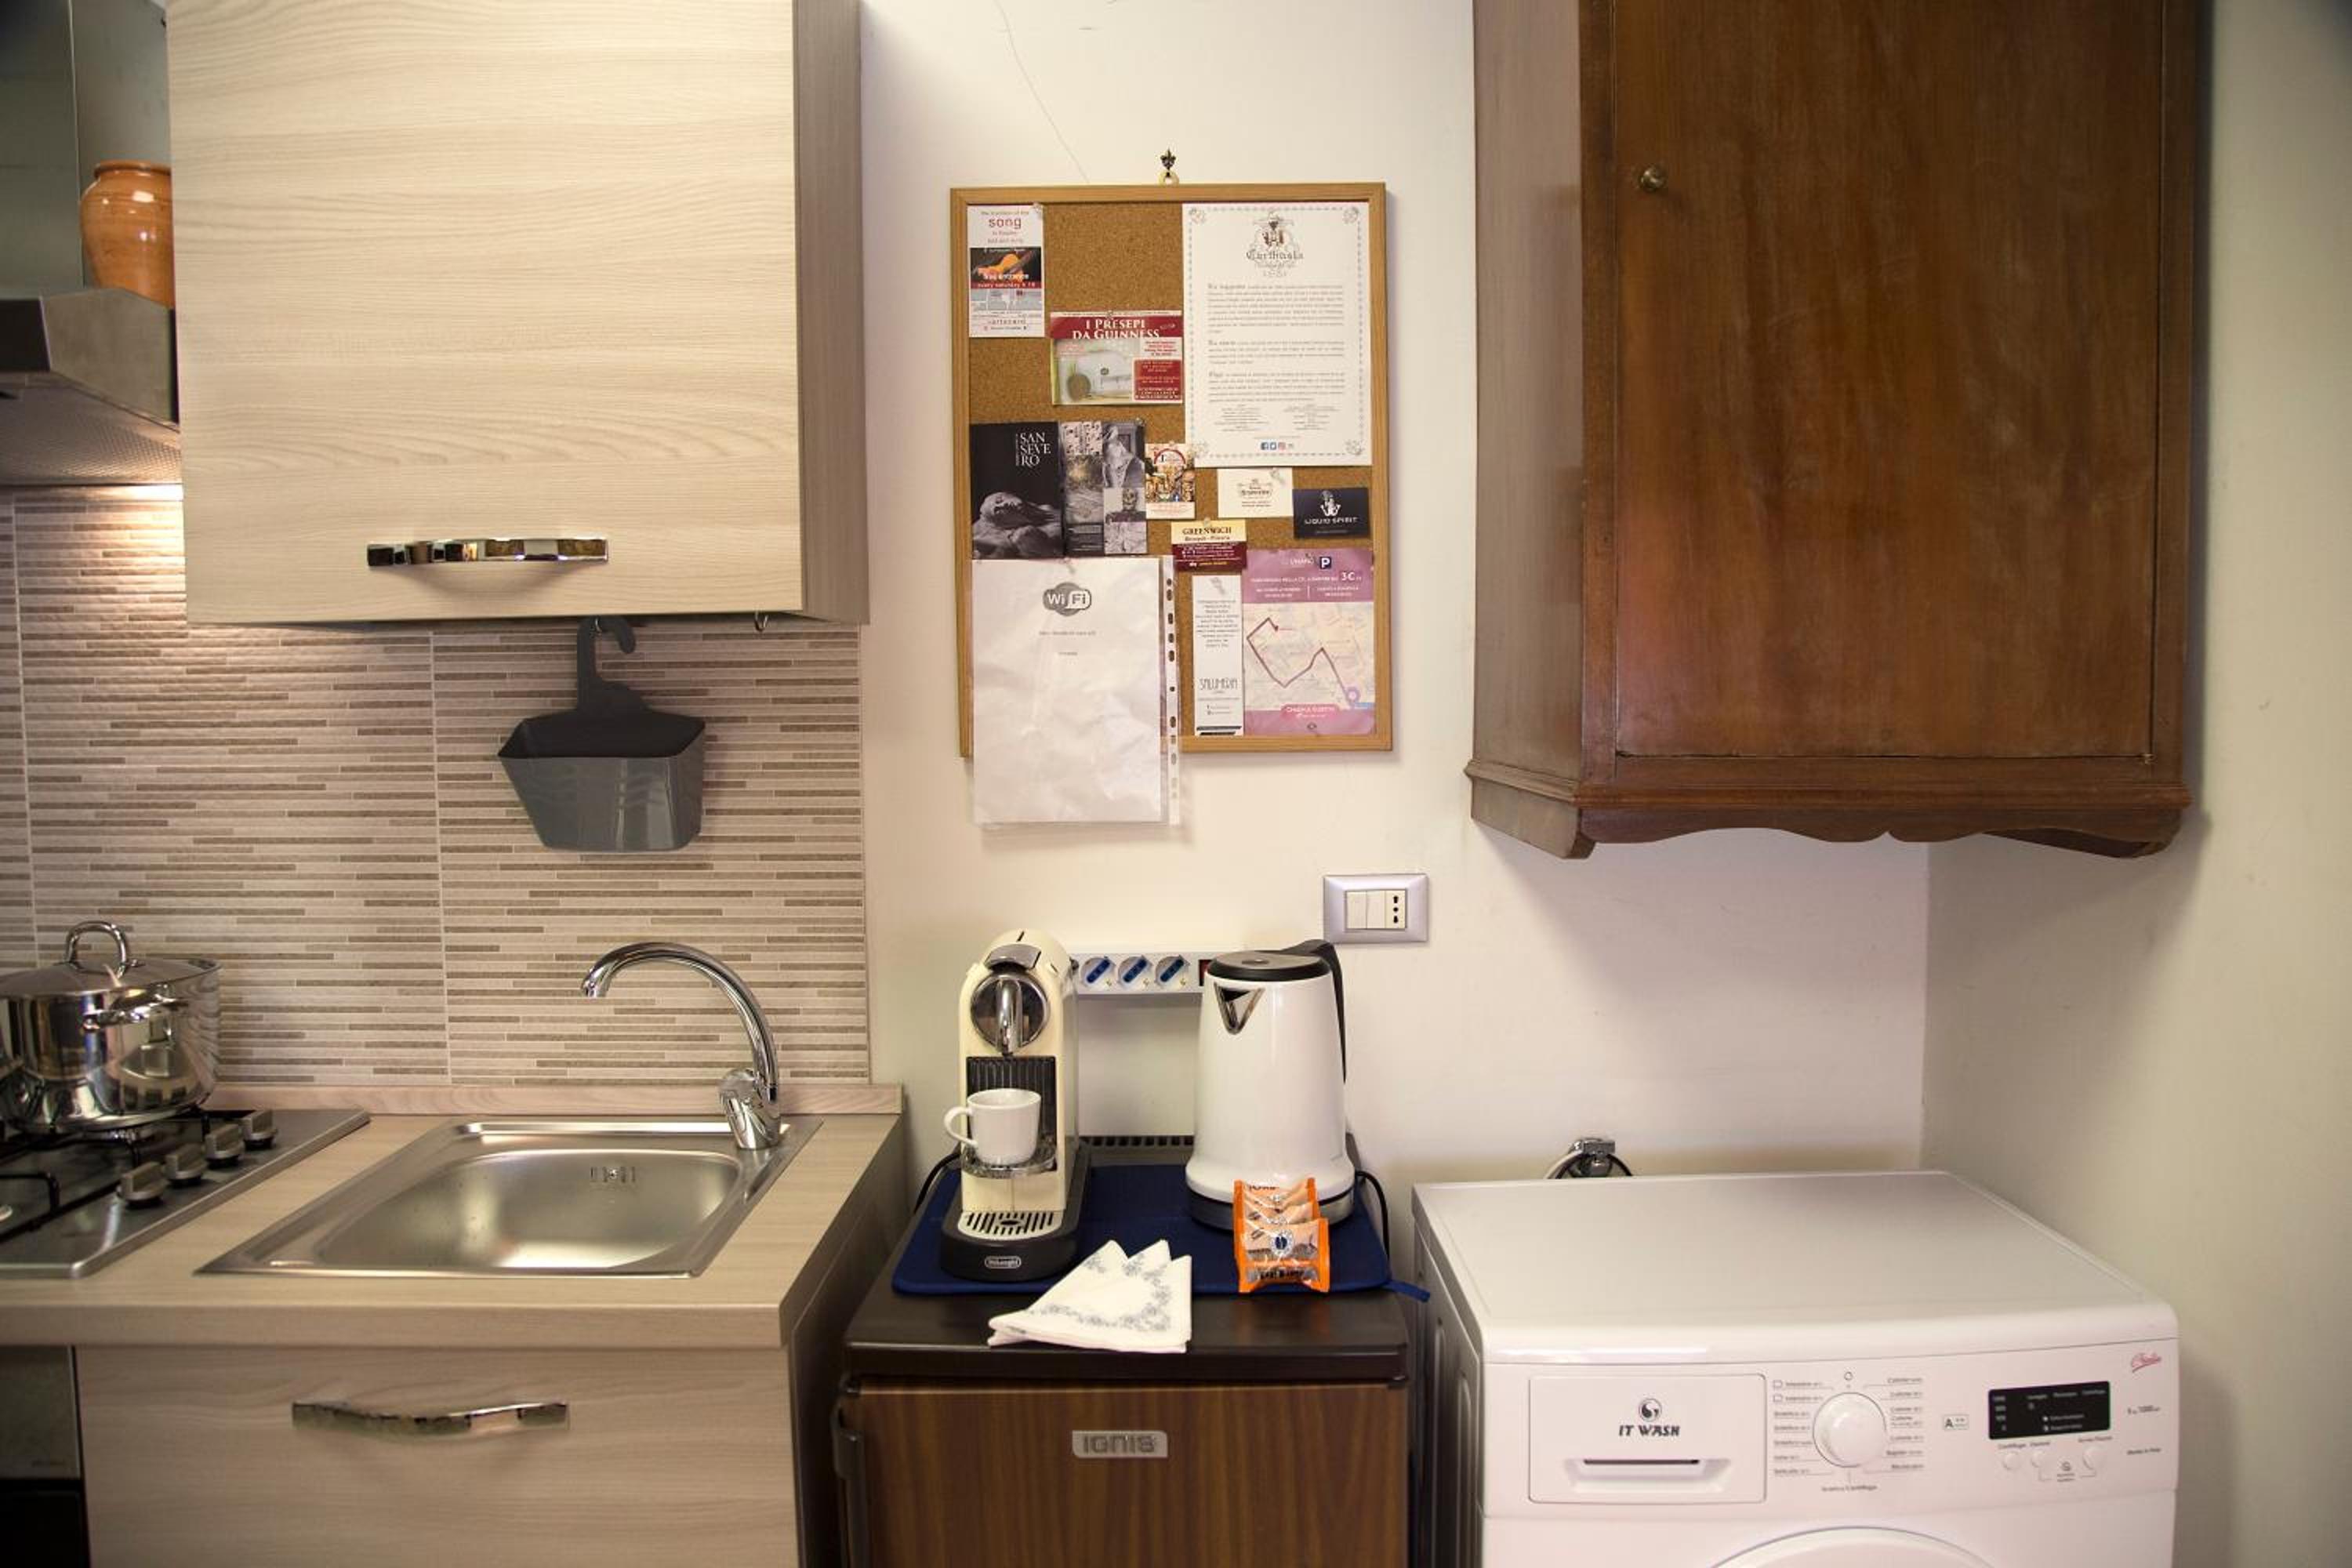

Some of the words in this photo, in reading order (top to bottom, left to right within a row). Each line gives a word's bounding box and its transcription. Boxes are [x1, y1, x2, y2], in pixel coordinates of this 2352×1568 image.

[989, 218, 1022, 229] song
[1073, 330, 1091, 339] DA
[1094, 328, 1160, 339] GUINNESS
[1020, 432, 1045, 443] SAN
[1020, 443, 1051, 455] SEVE
[1021, 455, 1040, 467] RO
[1321, 557, 1330, 568] P
[1618, 1425, 1634, 1436] IT
[1639, 1425, 1680, 1436] WASH
[1083, 1436, 1156, 1454] IGNIS
